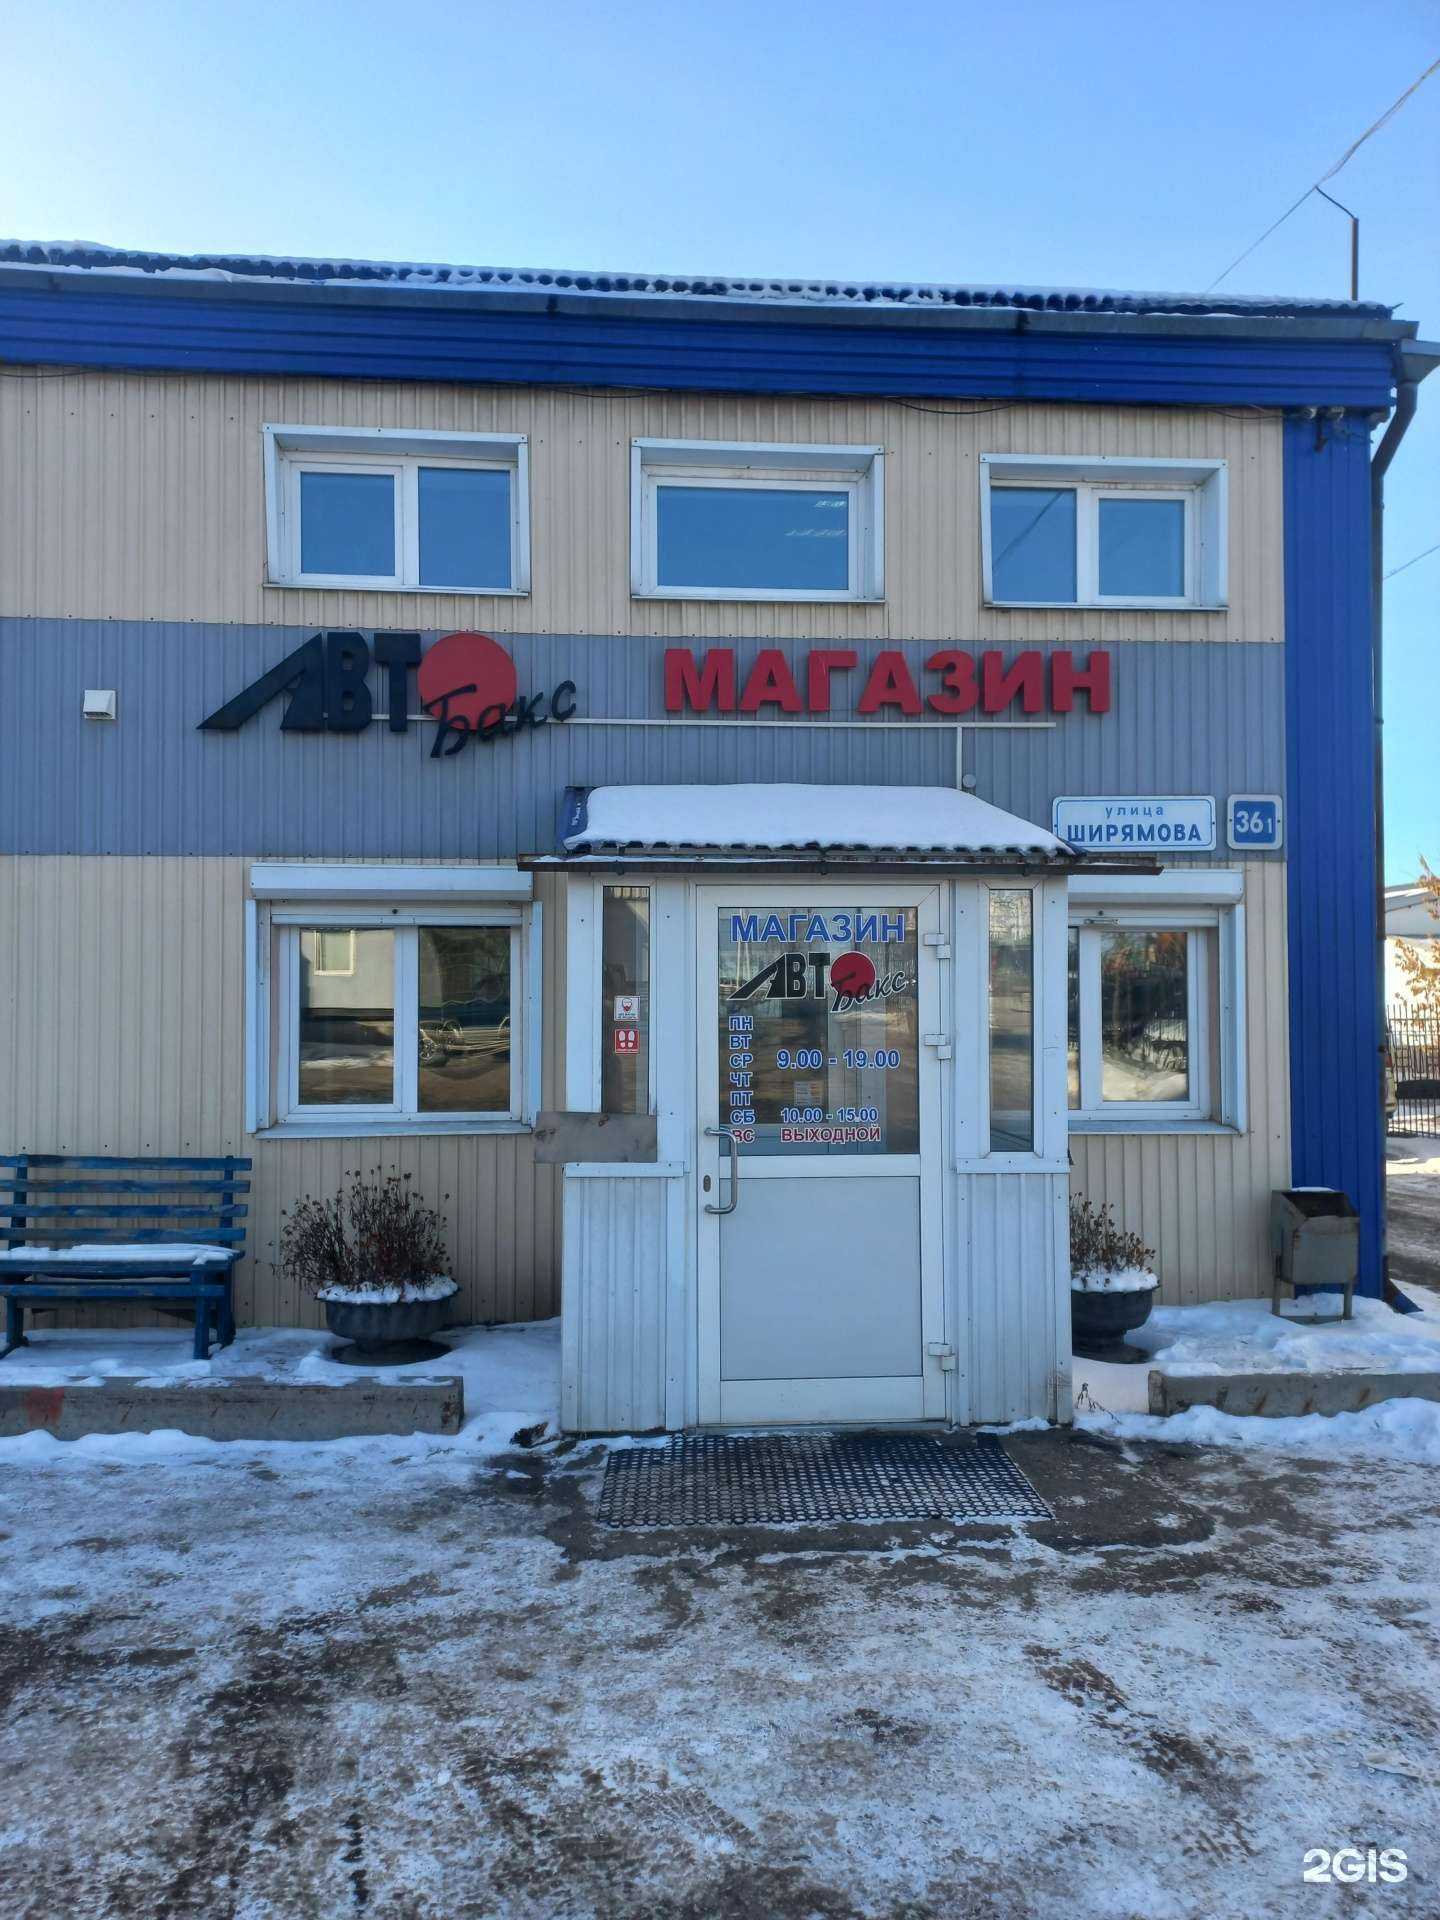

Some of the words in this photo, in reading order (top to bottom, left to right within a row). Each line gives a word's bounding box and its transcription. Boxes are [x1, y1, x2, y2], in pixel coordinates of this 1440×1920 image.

[664, 648, 1110, 715] МАГАЗИН
[422, 680, 577, 759] Бакс
[1105, 806, 1164, 819] улица
[1067, 823, 1203, 842] ШИРЯМОВА
[730, 914, 905, 943] МАГАЗИН
[729, 1015, 753, 1031] ПН
[729, 1035, 752, 1050] ВТ
[729, 1053, 753, 1069] СР
[776, 1049, 823, 1069] 9.00
[842, 1049, 900, 1069] 19.00
[729, 1072, 753, 1087] ЧТ
[730, 1091, 753, 1106] ПТ
[730, 1109, 756, 1125] СБ
[781, 1108, 823, 1123] 10.00
[837, 1108, 878, 1123] 15.00
[781, 1124, 881, 1144] ВЫХОДНОЙ
